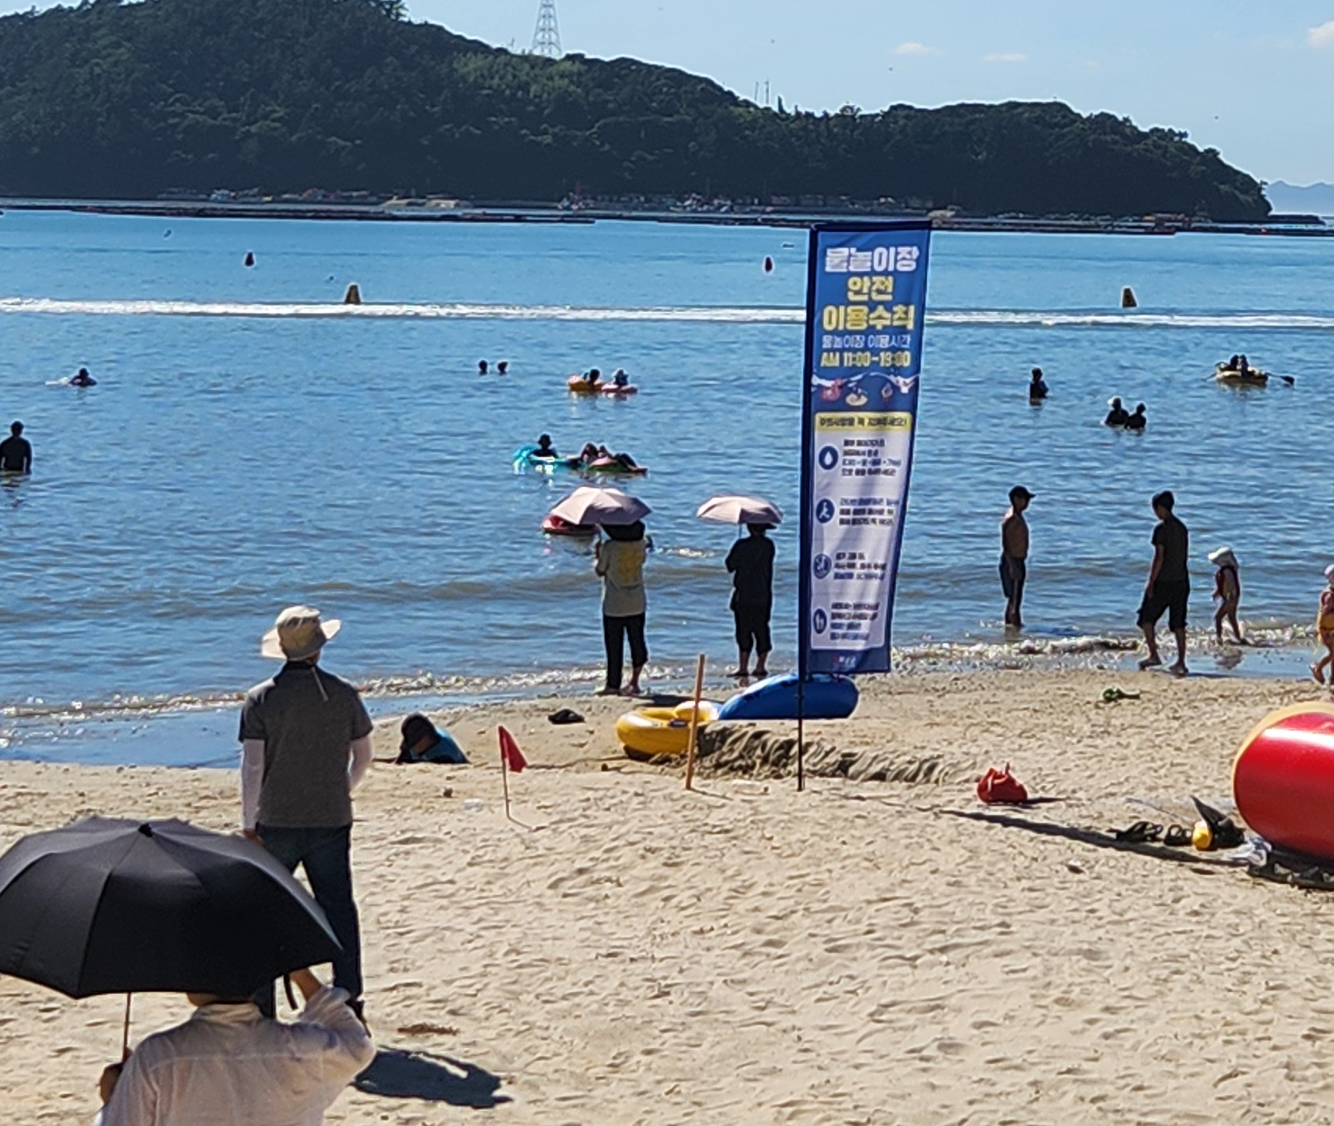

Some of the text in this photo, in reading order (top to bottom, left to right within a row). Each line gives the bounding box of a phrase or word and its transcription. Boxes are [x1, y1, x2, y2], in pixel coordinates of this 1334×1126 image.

[825, 246, 919, 273] 물놀이장
[847, 276, 894, 301] 안전
[822, 304, 915, 331] 이용수칙
[822, 334, 911, 349] 물놀이장 이용시간
[820, 352, 840, 367] AM
